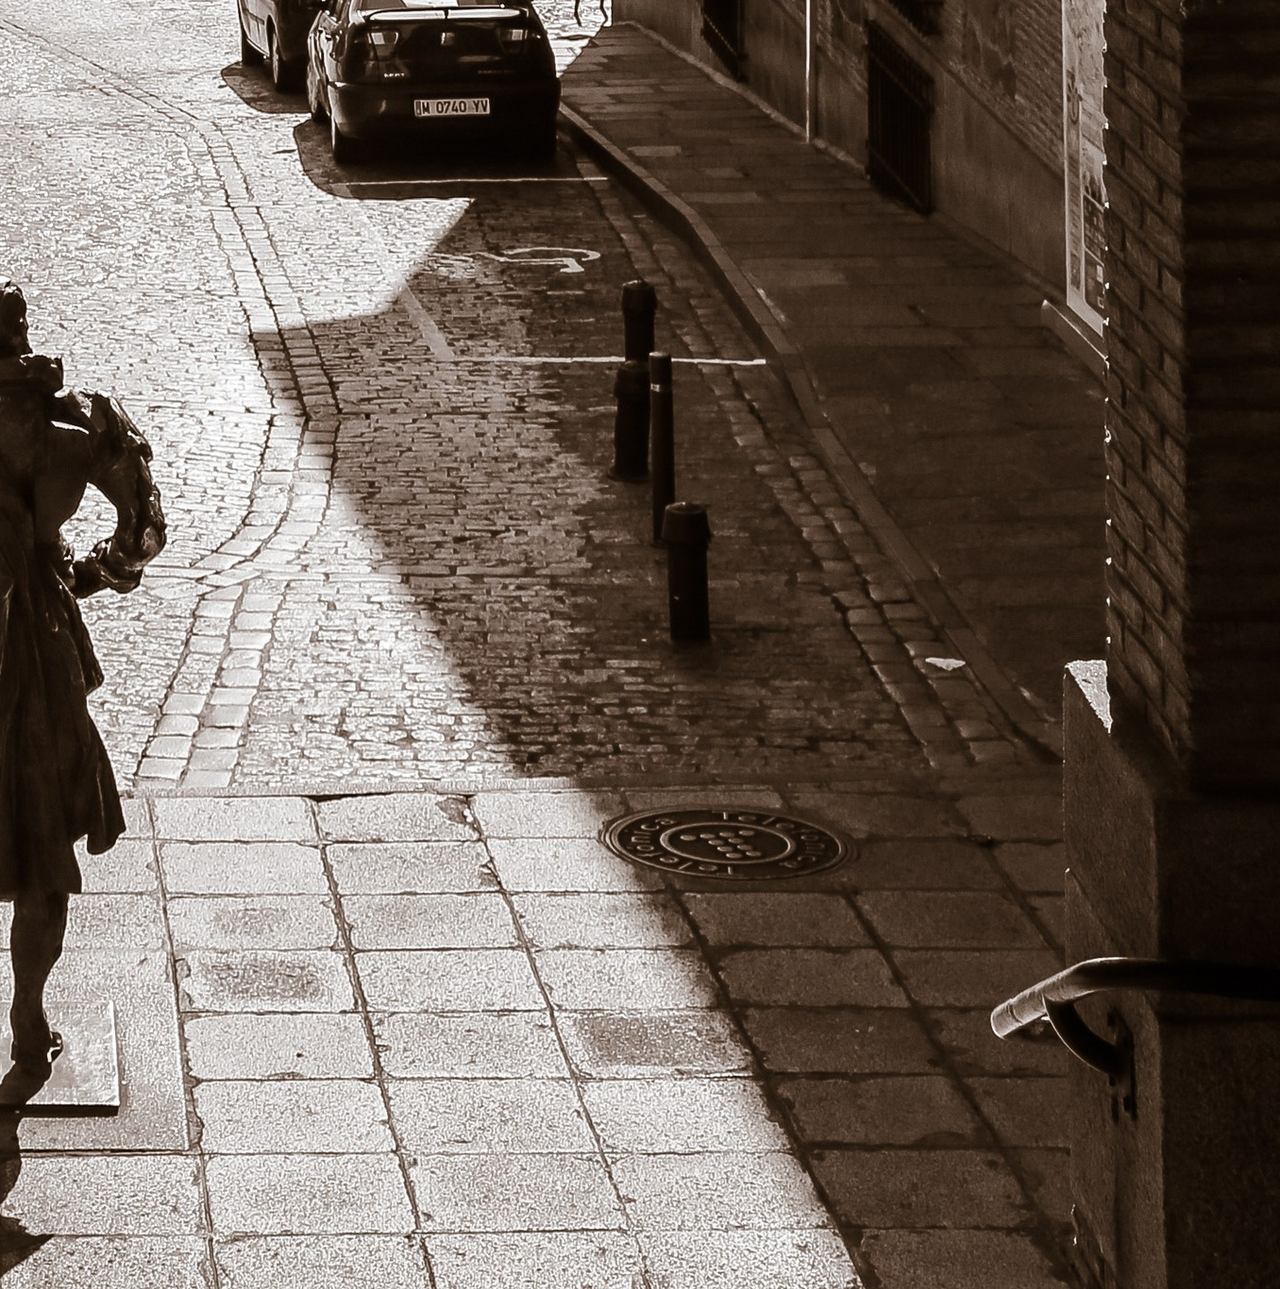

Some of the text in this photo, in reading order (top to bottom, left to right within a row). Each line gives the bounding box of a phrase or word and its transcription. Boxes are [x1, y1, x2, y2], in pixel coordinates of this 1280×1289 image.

[422, 99, 489, 114] M 0740 YV
